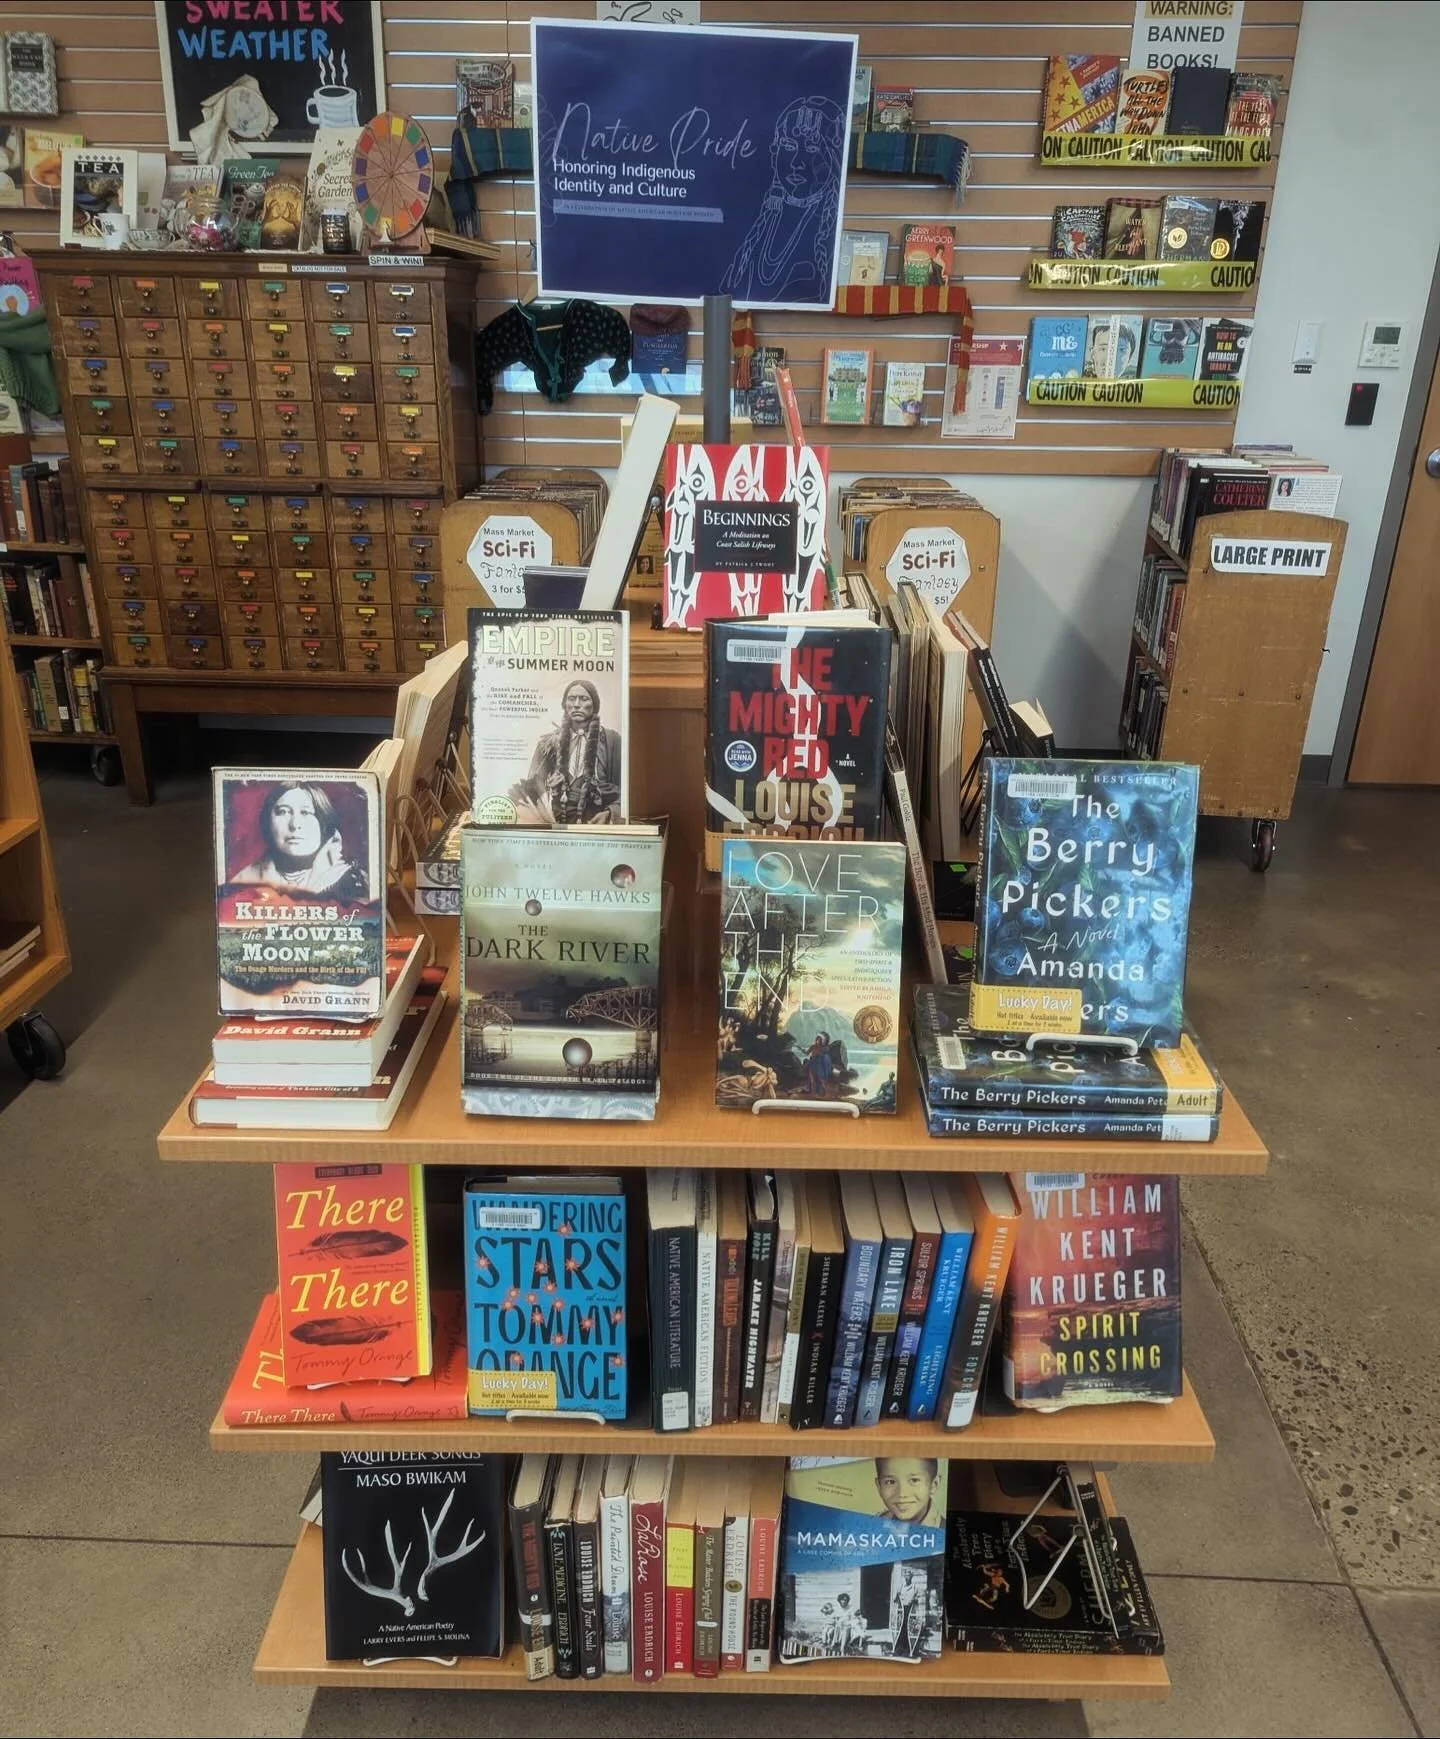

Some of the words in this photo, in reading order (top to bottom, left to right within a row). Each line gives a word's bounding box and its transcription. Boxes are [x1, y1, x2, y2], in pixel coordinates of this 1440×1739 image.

[184, 0, 344, 24] SWEATER
[1151, 0, 1233, 16] WARNING:
[176, 25, 329, 62] WEATHER
[1148, 26, 1224, 42] BANNED
[1147, 54, 1218, 70] BOOKS!
[553, 102, 659, 161] Native
[669, 106, 758, 170] Pride
[1068, 138, 1122, 160] CAUTION
[1127, 139, 1180, 161] CAUTION
[1190, 140, 1244, 162] CAUTION
[78, 162, 120, 174] TEA
[554, 160, 617, 179] Honoring
[622, 163, 696, 180] Indigenous
[554, 178, 605, 197] Identity
[609, 181, 633, 195] and
[638, 183, 687, 198] Culture
[905, 235, 952, 243] GREENWOOD
[370, 256, 391, 264] SPIN
[1106, 266, 1160, 286] CAUTION
[1037, 381, 1086, 401] CAUTION
[1093, 383, 1143, 403] CAUTION
[1213, 493, 1265, 505] COULTER
[1216, 483, 1265, 493] CATHERINE
[507, 528, 534, 536] Market
[703, 509, 791, 527] BEGINNINGS
[927, 539, 955, 547] Market
[1214, 545, 1266, 565] LARGE
[1271, 547, 1326, 568] PRINT
[482, 624, 615, 657] EMPIRE
[508, 658, 568, 671] SUMMER
[574, 660, 614, 672] MOON
[772, 648, 834, 691] THE
[728, 691, 870, 736] MIGHTY
[729, 753, 752, 761] JENNA
[763, 737, 829, 779] RED
[1094, 774, 1177, 786] BESTSELLER
[735, 779, 856, 824] LOUISE
[1072, 794, 1121, 819] The
[1026, 827, 1155, 876] Berry
[728, 850, 862, 893] LOVE
[466, 886, 507, 898] JOHN
[513, 887, 583, 901] TWELVE
[590, 890, 651, 904] HAWKS
[1002, 881, 1171, 922] Pickers
[235, 902, 338, 921] KILLERS
[343, 908, 359, 927] of
[724, 890, 880, 933] AFTER
[242, 928, 262, 941] the
[264, 926, 364, 942] FLOWER
[518, 925, 549, 936] THE
[1037, 933, 1058, 953] A
[1065, 926, 1119, 951] Novel
[243, 943, 312, 962] MOON
[467, 936, 545, 961] DARK
[559, 941, 651, 964] RIVER
[724, 931, 818, 971] THE
[1016, 953, 1144, 983] Amanda
[282, 995, 321, 1005] DAVID
[325, 995, 370, 1006] GRANN
[1000, 994, 1038, 1010] Lucky
[1042, 996, 1072, 1011] Day!
[223, 1026, 289, 1036] David
[292, 1026, 362, 1036] Grann
[941, 1087, 969, 1100] The
[975, 1089, 1021, 1105] Berry
[1026, 1090, 1086, 1105] Pickers
[1104, 1095, 1144, 1106] Amanda
[1177, 1094, 1209, 1107] Adult
[942, 1118, 970, 1132] The
[976, 1119, 1022, 1134] Berry
[1026, 1120, 1086, 1134] Pickers
[1104, 1123, 1143, 1132] Amanda
[286, 1184, 404, 1230] There
[1030, 1184, 1161, 1220] WILLIAM
[670, 1237, 681, 1269] NATIVE
[918, 1242, 932, 1269] SULFUR
[988, 1227, 1008, 1269] WILLIAM
[1059, 1228, 1135, 1261] KENT
[474, 1236, 623, 1291] STARS
[701, 1252, 711, 1289] NATIVE
[856, 1245, 873, 1288] BOUNDARY
[888, 1247, 905, 1274] IRON
[949, 1247, 964, 1288] WILLIAM
[290, 1266, 409, 1313] There
[820, 1256, 831, 1296] SHERMAN
[911, 1270, 927, 1300] SPRINGS
[1030, 1268, 1167, 1306] KRUEGER
[670, 1271, 681, 1318] AMERICAN
[750, 1278, 763, 1326] JAMAKE
[849, 1290, 865, 1321] WATERS
[883, 1280, 901, 1309] LAKE
[474, 1303, 624, 1346] TOMMY
[700, 1291, 710, 1342] AMERICAN
[816, 1299, 826, 1328] ALEXIE
[1059, 1311, 1140, 1341] SPIRIT
[670, 1320, 681, 1369] LITERATURE
[745, 1327, 759, 1389] HIGHWATER
[810, 1343, 820, 1373] INDIAN
[290, 1351, 354, 1375] Tommy
[359, 1349, 413, 1369] Orange
[699, 1345, 710, 1383] FICTION
[1040, 1345, 1161, 1377] CROSSING
[481, 1376, 517, 1390] Lucky
[521, 1377, 549, 1390] Day!
[806, 1374, 817, 1405] KILLER
[240, 1409, 287, 1424] There
[290, 1407, 336, 1423] There
[356, 1472, 401, 1487] MASO
[406, 1471, 466, 1485] BWIKAM
[579, 1540, 593, 1567] LOUISE
[636, 1514, 662, 1585] LaRose
[797, 1532, 936, 1549] MAMASKATCH
[581, 1570, 594, 1603] ERDRICH
[581, 1607, 596, 1629] Four
[644, 1591, 653, 1624] LOUISE
[386, 1624, 405, 1632] Native
[406, 1623, 434, 1631] American
[435, 1622, 455, 1630] Poetry
[645, 1624, 654, 1663] ERDRICH
